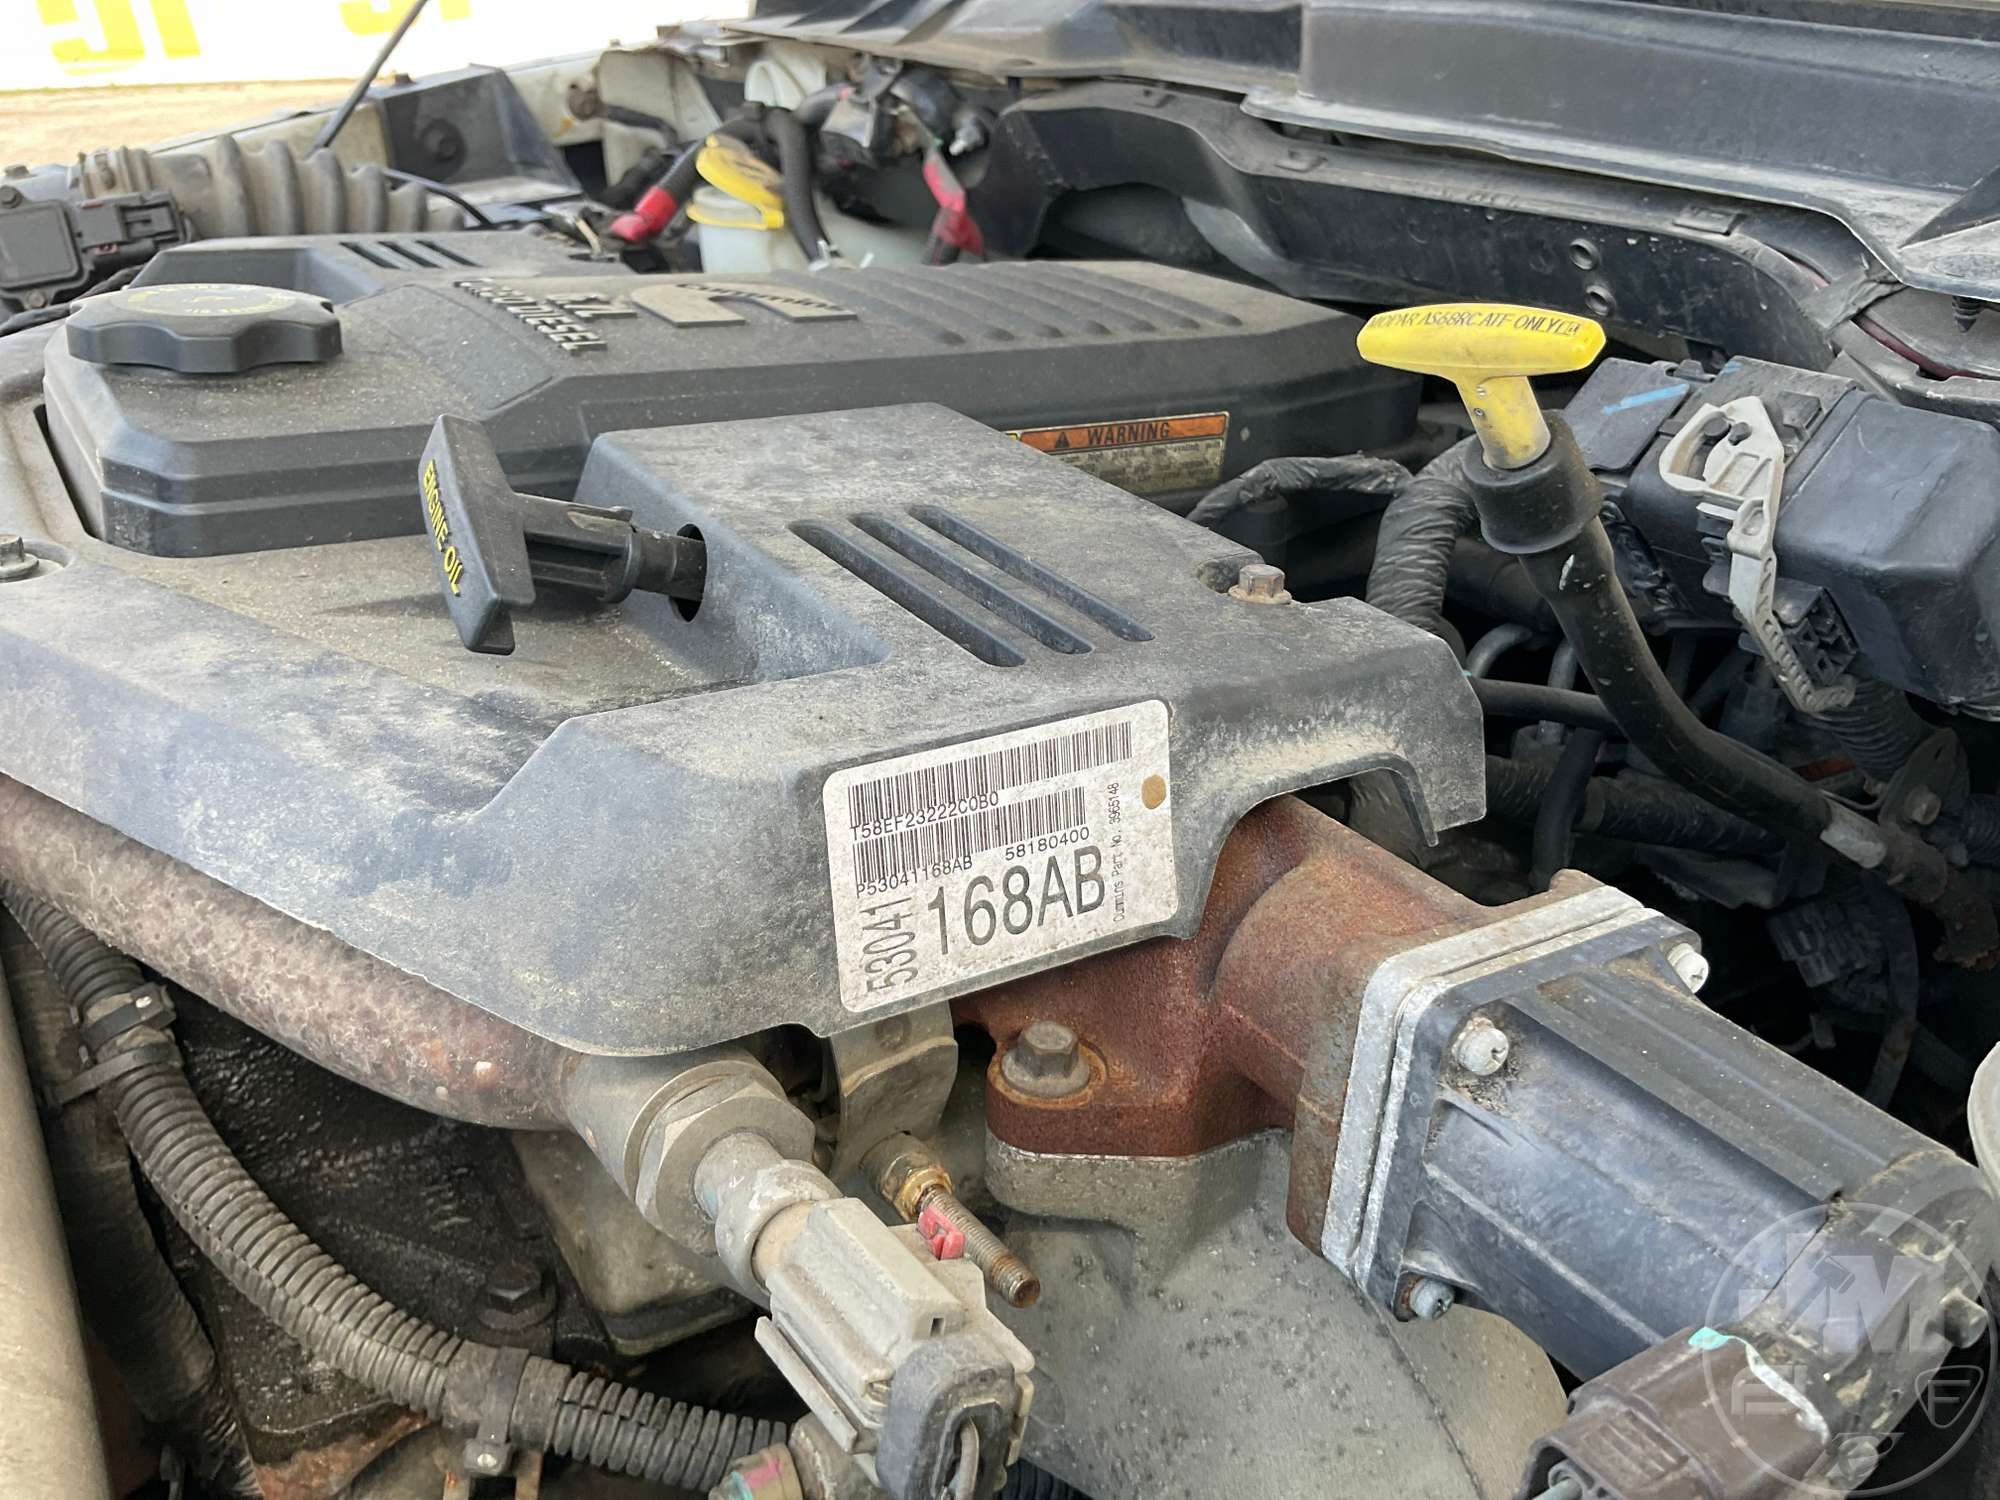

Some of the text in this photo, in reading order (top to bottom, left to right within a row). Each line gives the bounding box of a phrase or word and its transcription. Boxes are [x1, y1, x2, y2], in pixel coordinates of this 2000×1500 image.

[507, 304, 607, 350] DIESEL
[1418, 311, 1479, 327] AS68RC
[1480, 312, 1513, 327] ATF
[1513, 316, 1559, 334] ONLY
[1087, 422, 1170, 446] WARNING
[424, 458, 464, 596] ENGINE OIL
[1107, 782, 1121, 825] 3965148
[1111, 830, 1123, 848] No.
[856, 827, 1090, 899] P53041168AB 58180400
[1111, 852, 1124, 877] Part
[859, 845, 1105, 993] 53041 168AB
